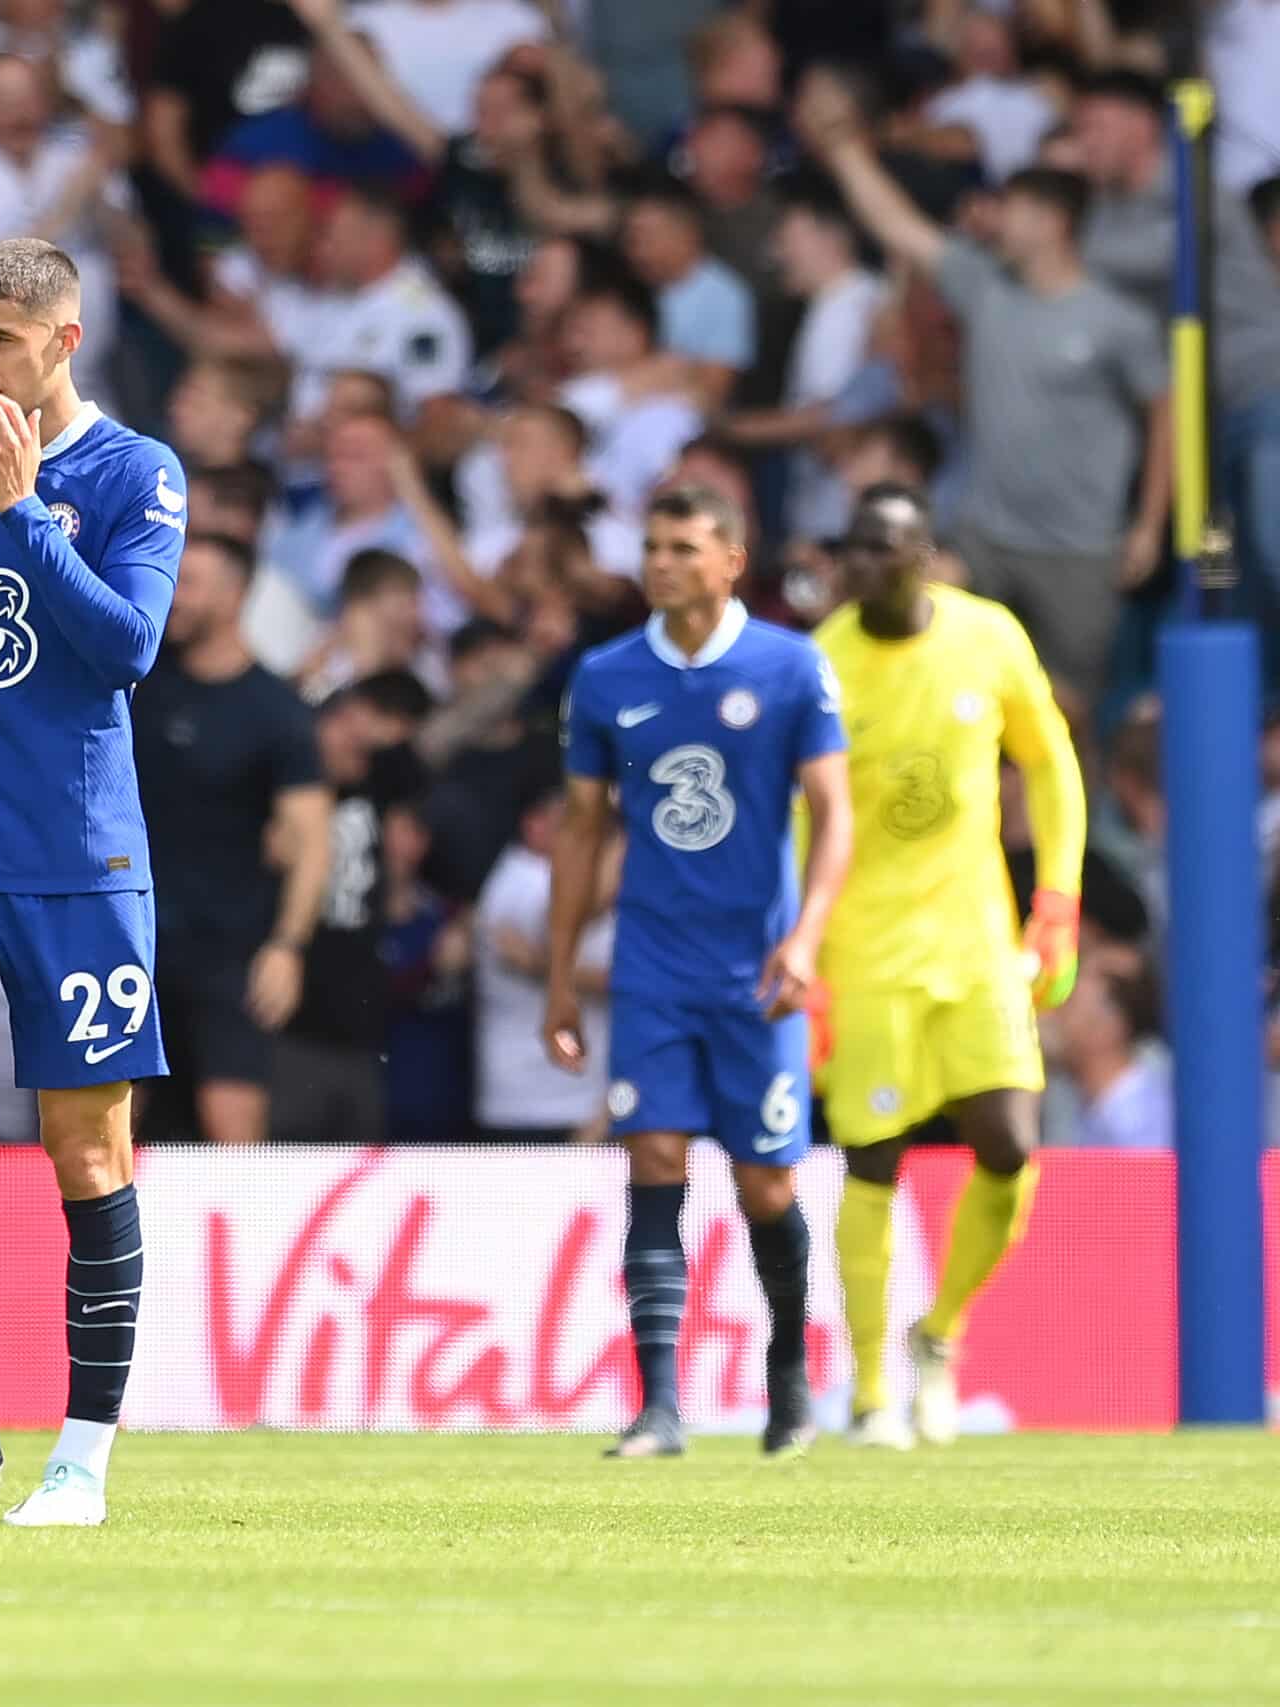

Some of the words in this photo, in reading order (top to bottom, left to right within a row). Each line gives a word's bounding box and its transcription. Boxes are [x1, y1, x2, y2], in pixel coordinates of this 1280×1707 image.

[649, 743, 736, 851] 3
[877, 750, 960, 841] 3
[60, 964, 151, 1042] 29
[761, 1071, 800, 1135] 6
